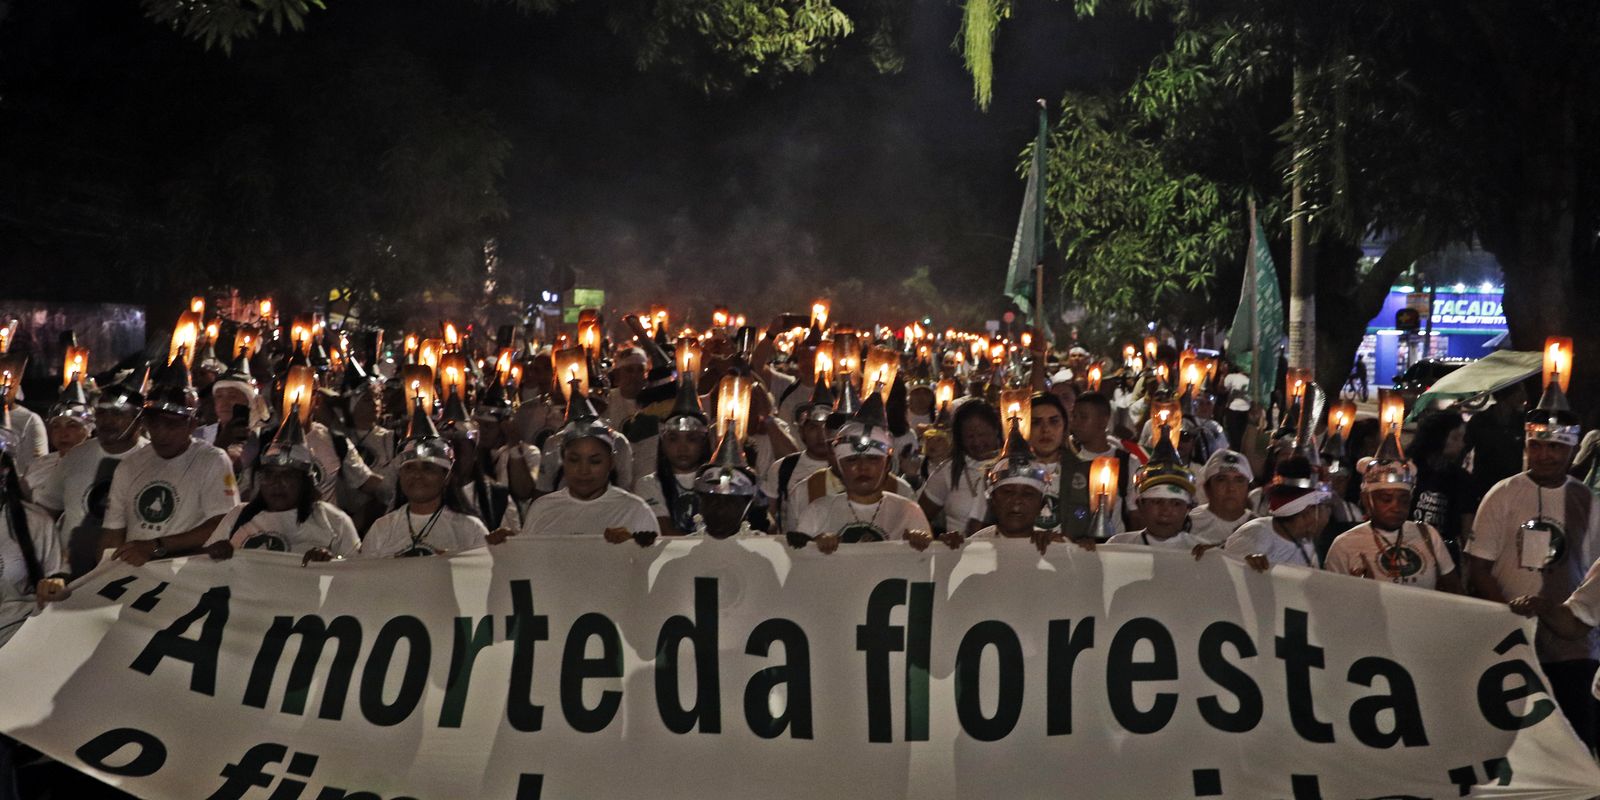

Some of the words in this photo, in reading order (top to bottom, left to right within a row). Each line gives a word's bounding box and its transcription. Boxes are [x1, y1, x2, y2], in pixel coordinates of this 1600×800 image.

[242, 580, 623, 735] morte
[642, 577, 813, 741] da
[857, 579, 1429, 750] floresta
